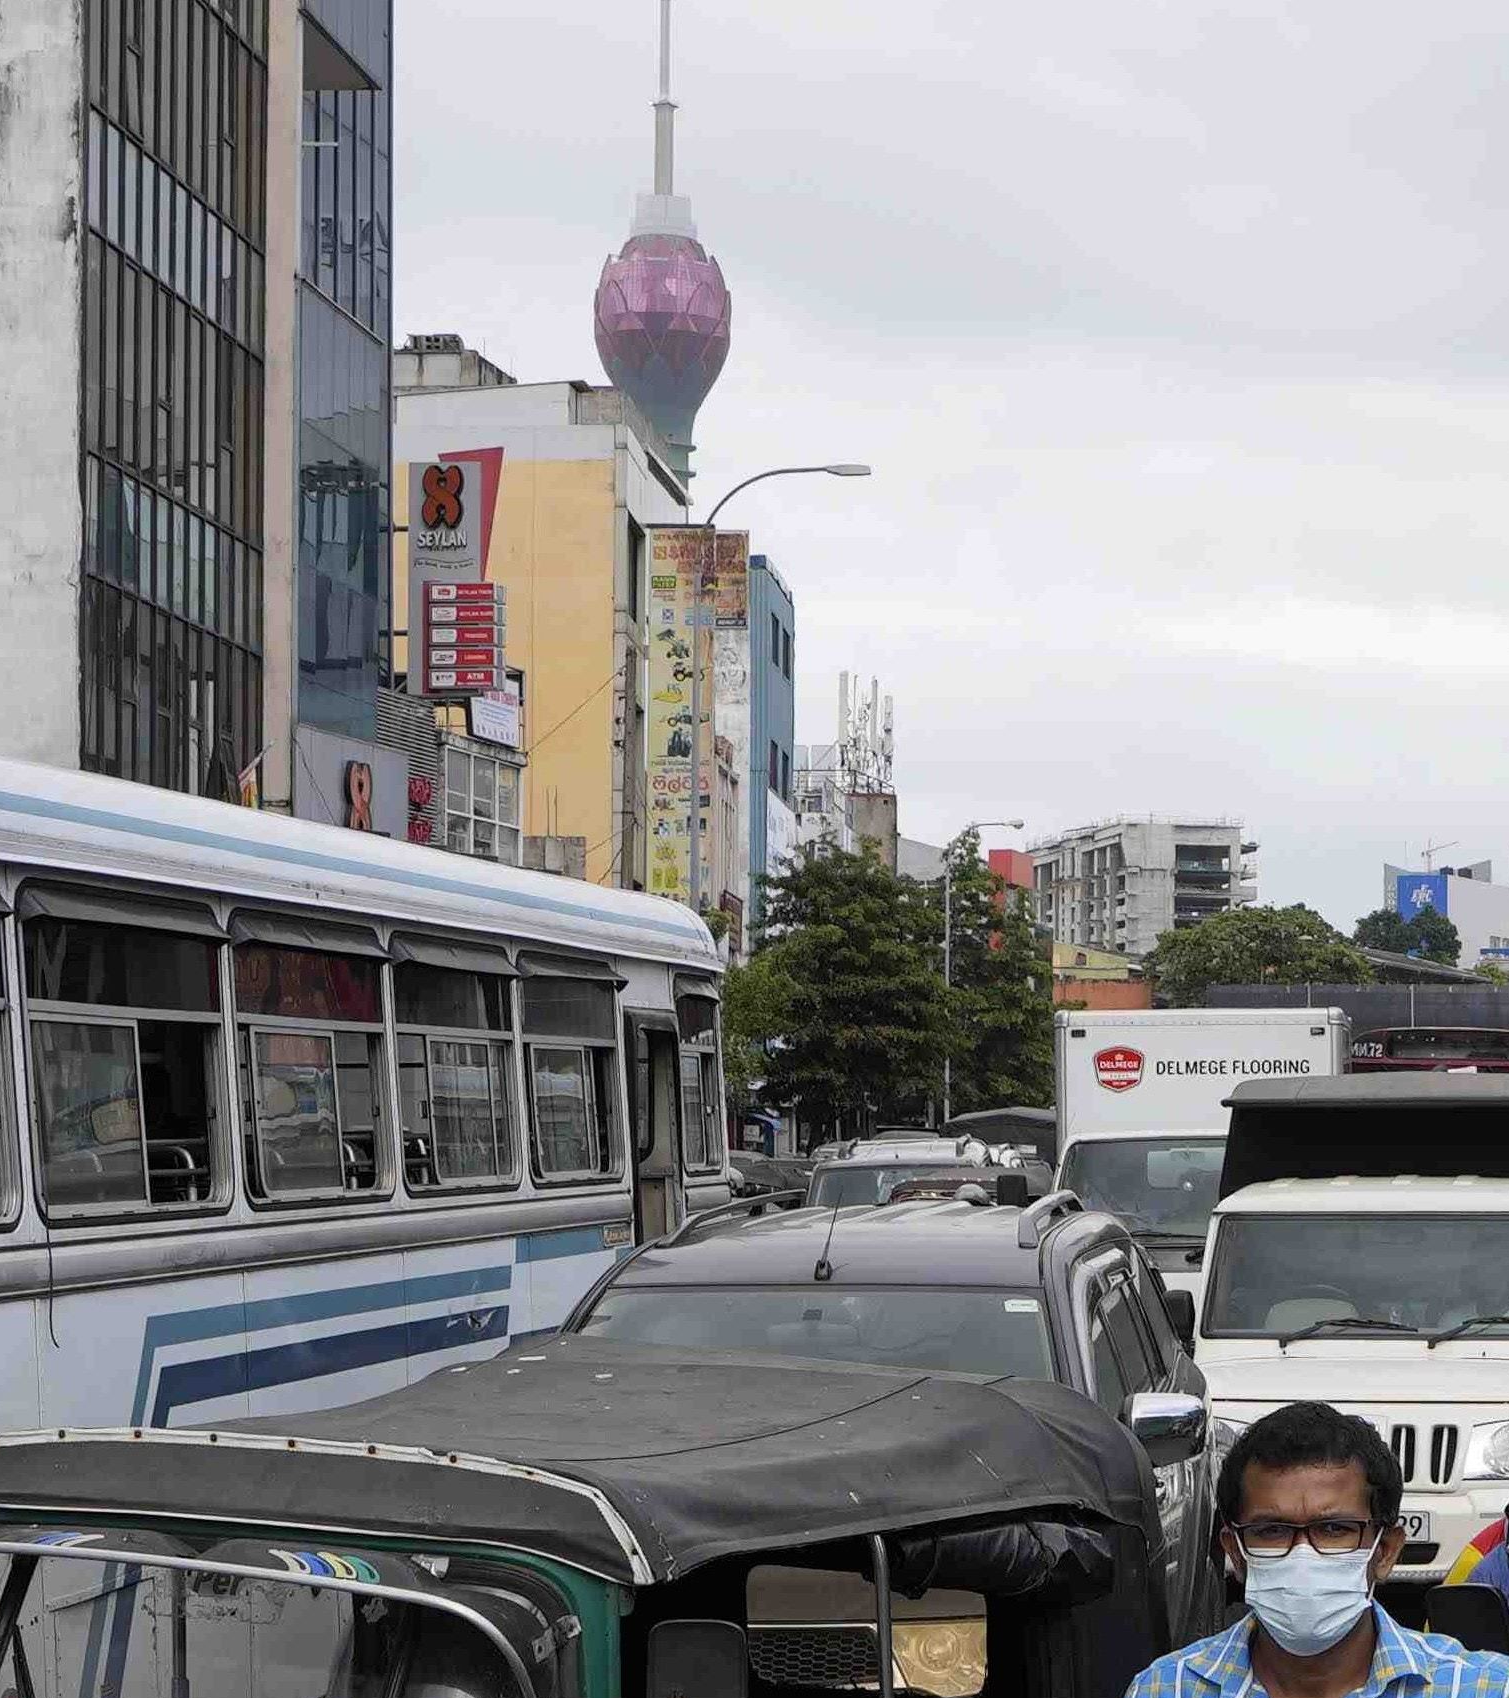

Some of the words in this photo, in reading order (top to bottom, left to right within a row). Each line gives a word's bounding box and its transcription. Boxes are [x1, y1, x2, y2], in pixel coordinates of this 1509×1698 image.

[417, 529, 468, 549] SEYLAN
[467, 672, 485, 681] ATM
[1156, 1060, 1228, 1075] DELMEGE
[1232, 1059, 1311, 1075] FLOORING
